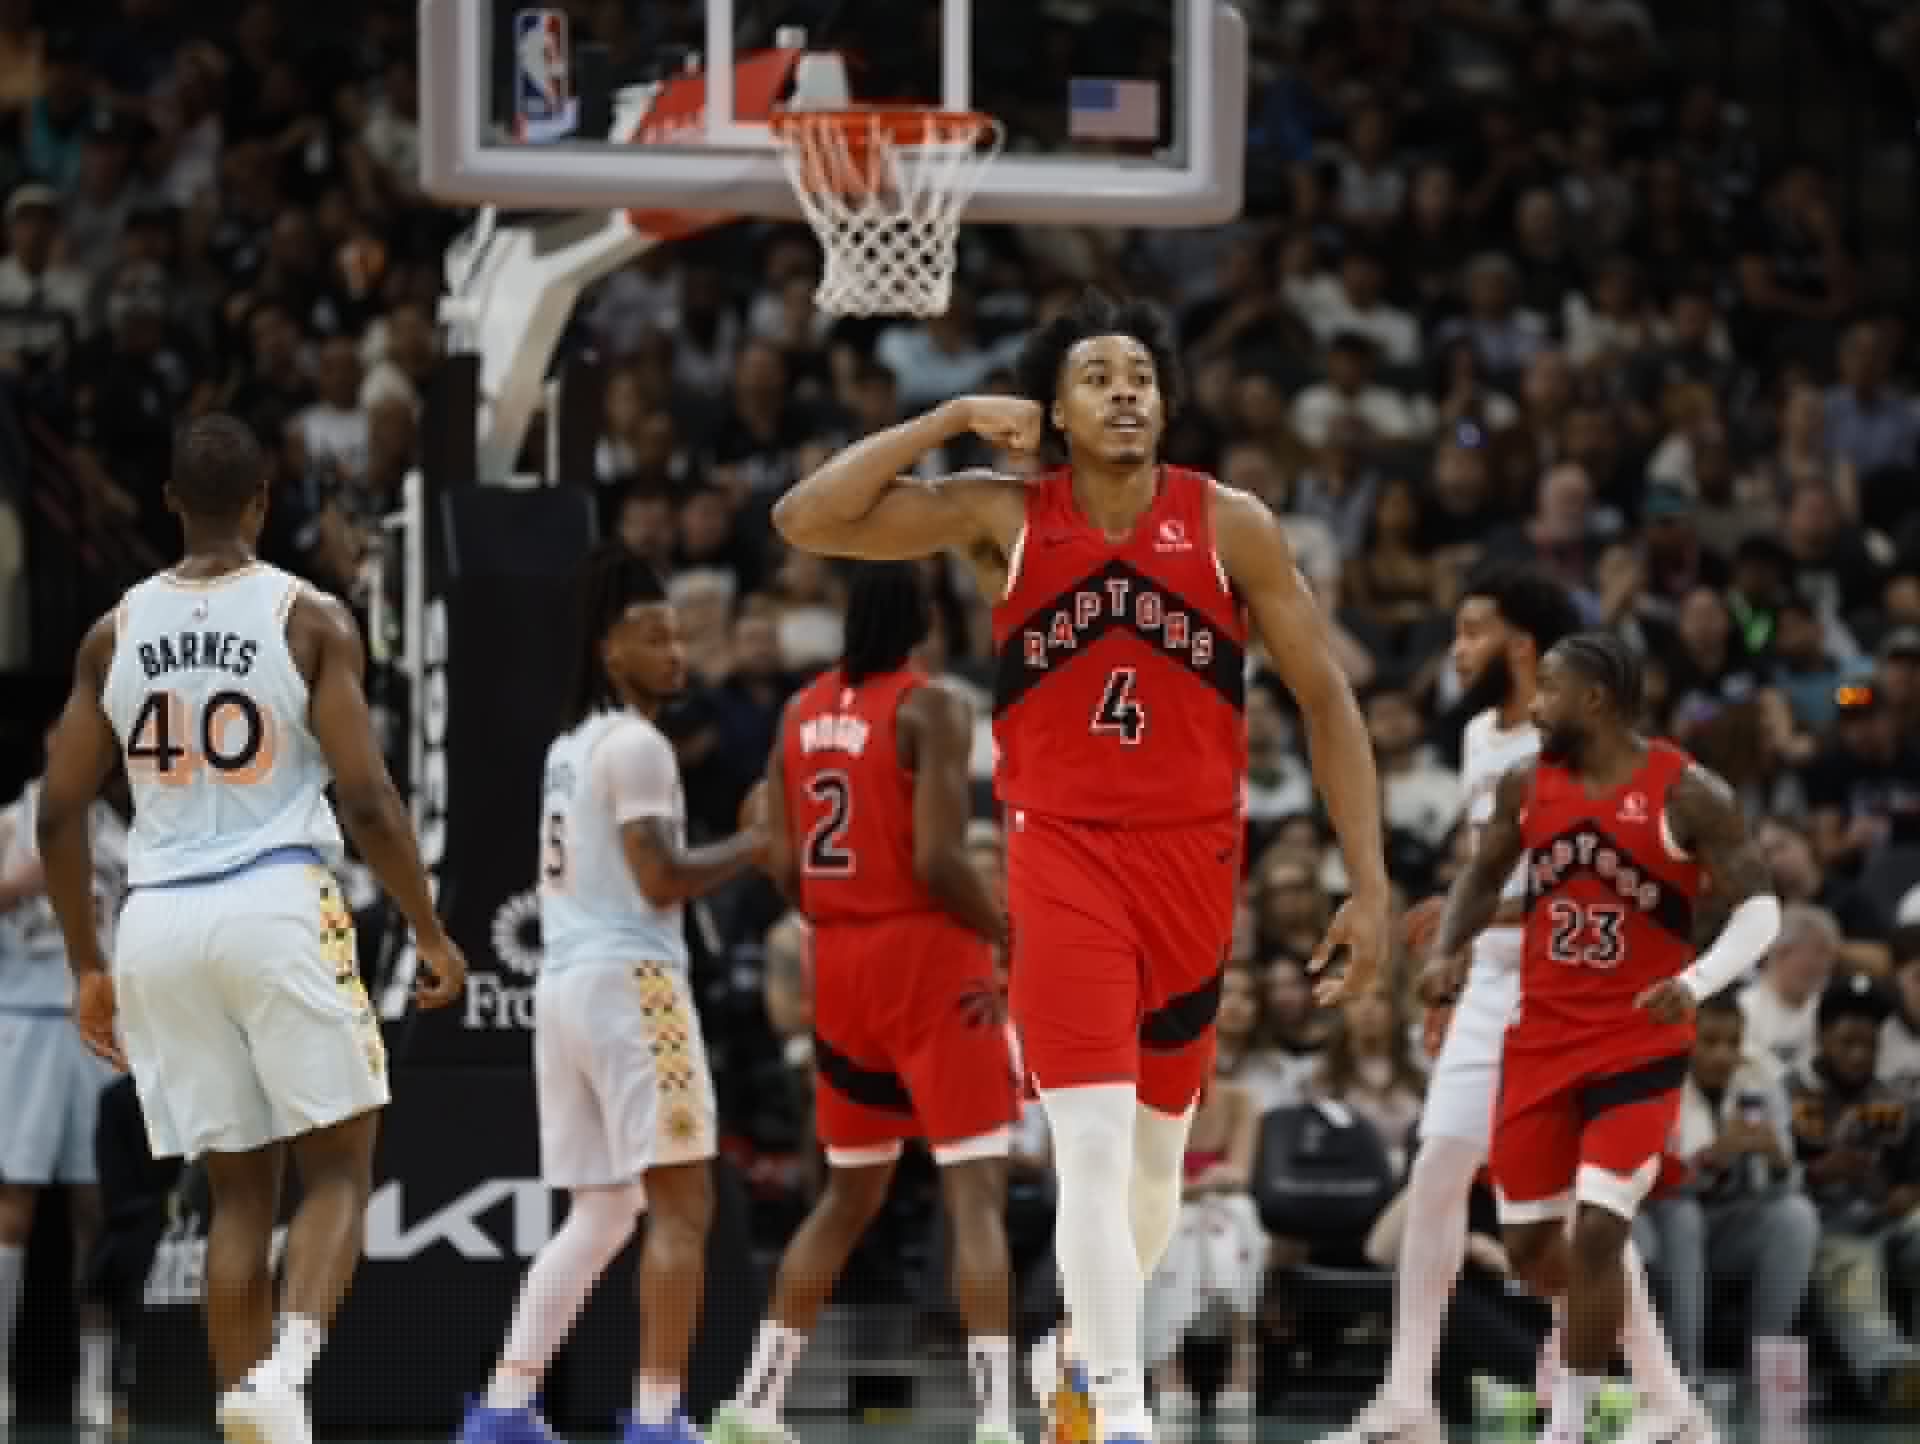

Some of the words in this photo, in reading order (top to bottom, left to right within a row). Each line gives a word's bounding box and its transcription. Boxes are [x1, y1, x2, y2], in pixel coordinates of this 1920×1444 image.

[137, 632, 258, 679] BARNES
[1023, 577, 1214, 670] RAPTORS
[127, 690, 266, 776] 40
[1088, 667, 1145, 745] 4
[801, 768, 857, 880] 2
[1528, 832, 1661, 911] APTORS
[1546, 898, 1627, 969] 23
[463, 970, 537, 1031] Fro
[364, 1177, 556, 1261] KI
